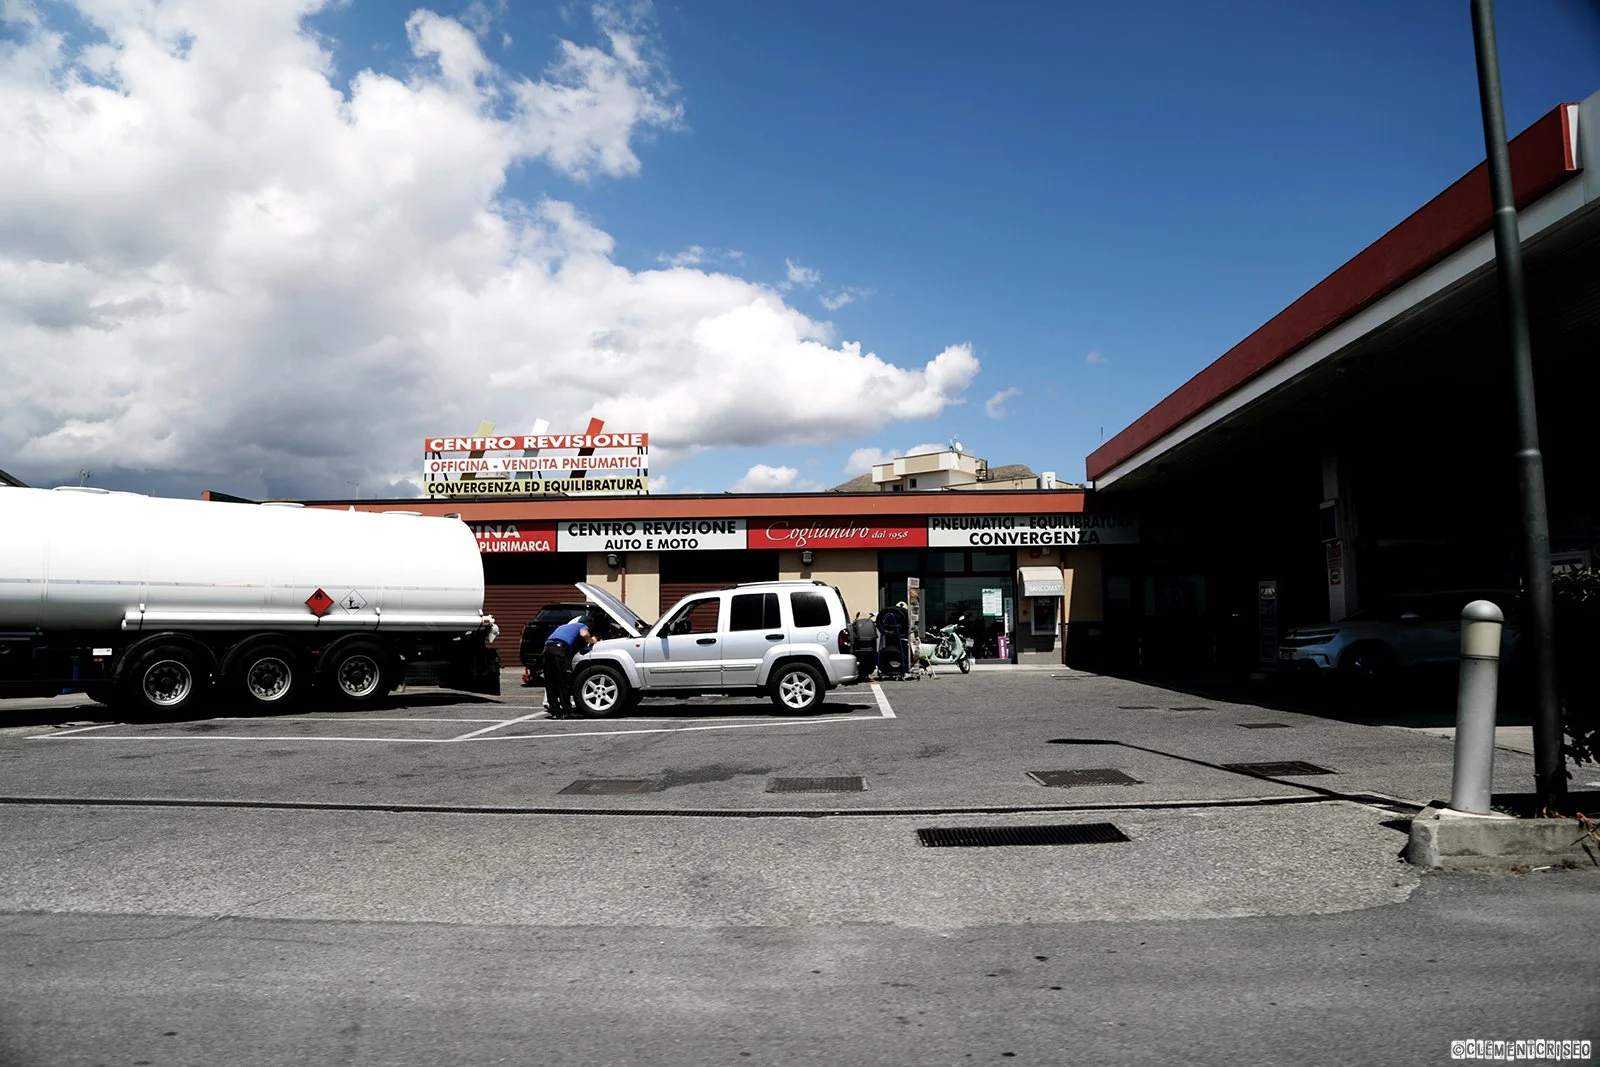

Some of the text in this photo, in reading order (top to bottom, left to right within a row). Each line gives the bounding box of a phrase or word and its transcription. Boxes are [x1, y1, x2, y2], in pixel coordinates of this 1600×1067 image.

[430, 434, 643, 452] CENTRO REVISIONE
[430, 459, 489, 472] OFFICINA
[502, 458, 558, 471] VENDITA
[562, 456, 642, 469] PNEUMATICI
[428, 478, 643, 494] CONVERGENZA ED EQUILIBRATURA
[567, 520, 736, 537] CENTRO REVISIONE
[932, 516, 1015, 530] PNEUMATICI
[1029, 515, 1134, 531] EQUILIBRATURA
[470, 524, 521, 539] INA
[871, 530, 887, 539] dal
[969, 530, 1100, 545] CONVERGENZA
[479, 540, 551, 553] PLURIMARCA
[604, 538, 699, 550] AUTO E MOTO
